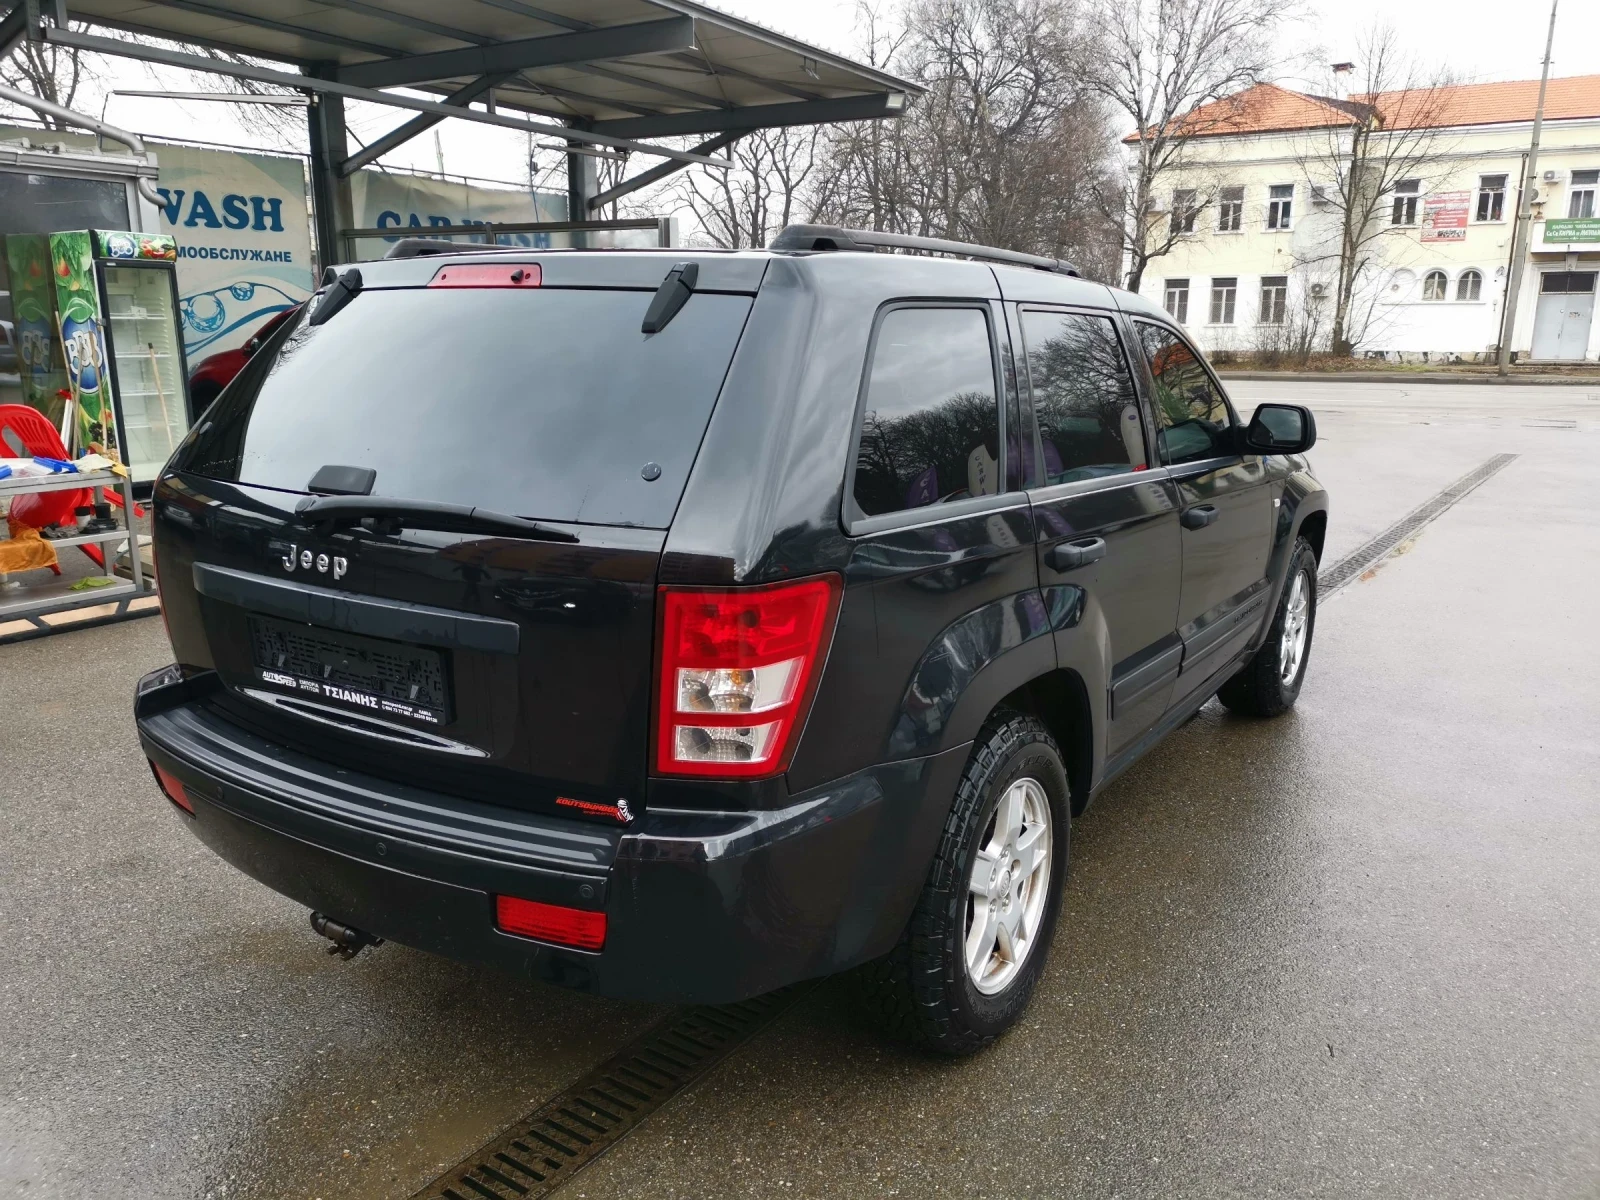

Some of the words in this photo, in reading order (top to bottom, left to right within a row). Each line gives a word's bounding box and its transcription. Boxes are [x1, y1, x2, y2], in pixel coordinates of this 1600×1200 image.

[177, 246, 292, 263] МООБСЛУЖАНЕ
[282, 544, 348, 580] Jeep
[322, 684, 379, 709] ΤΣΙΑΝΗΣ
